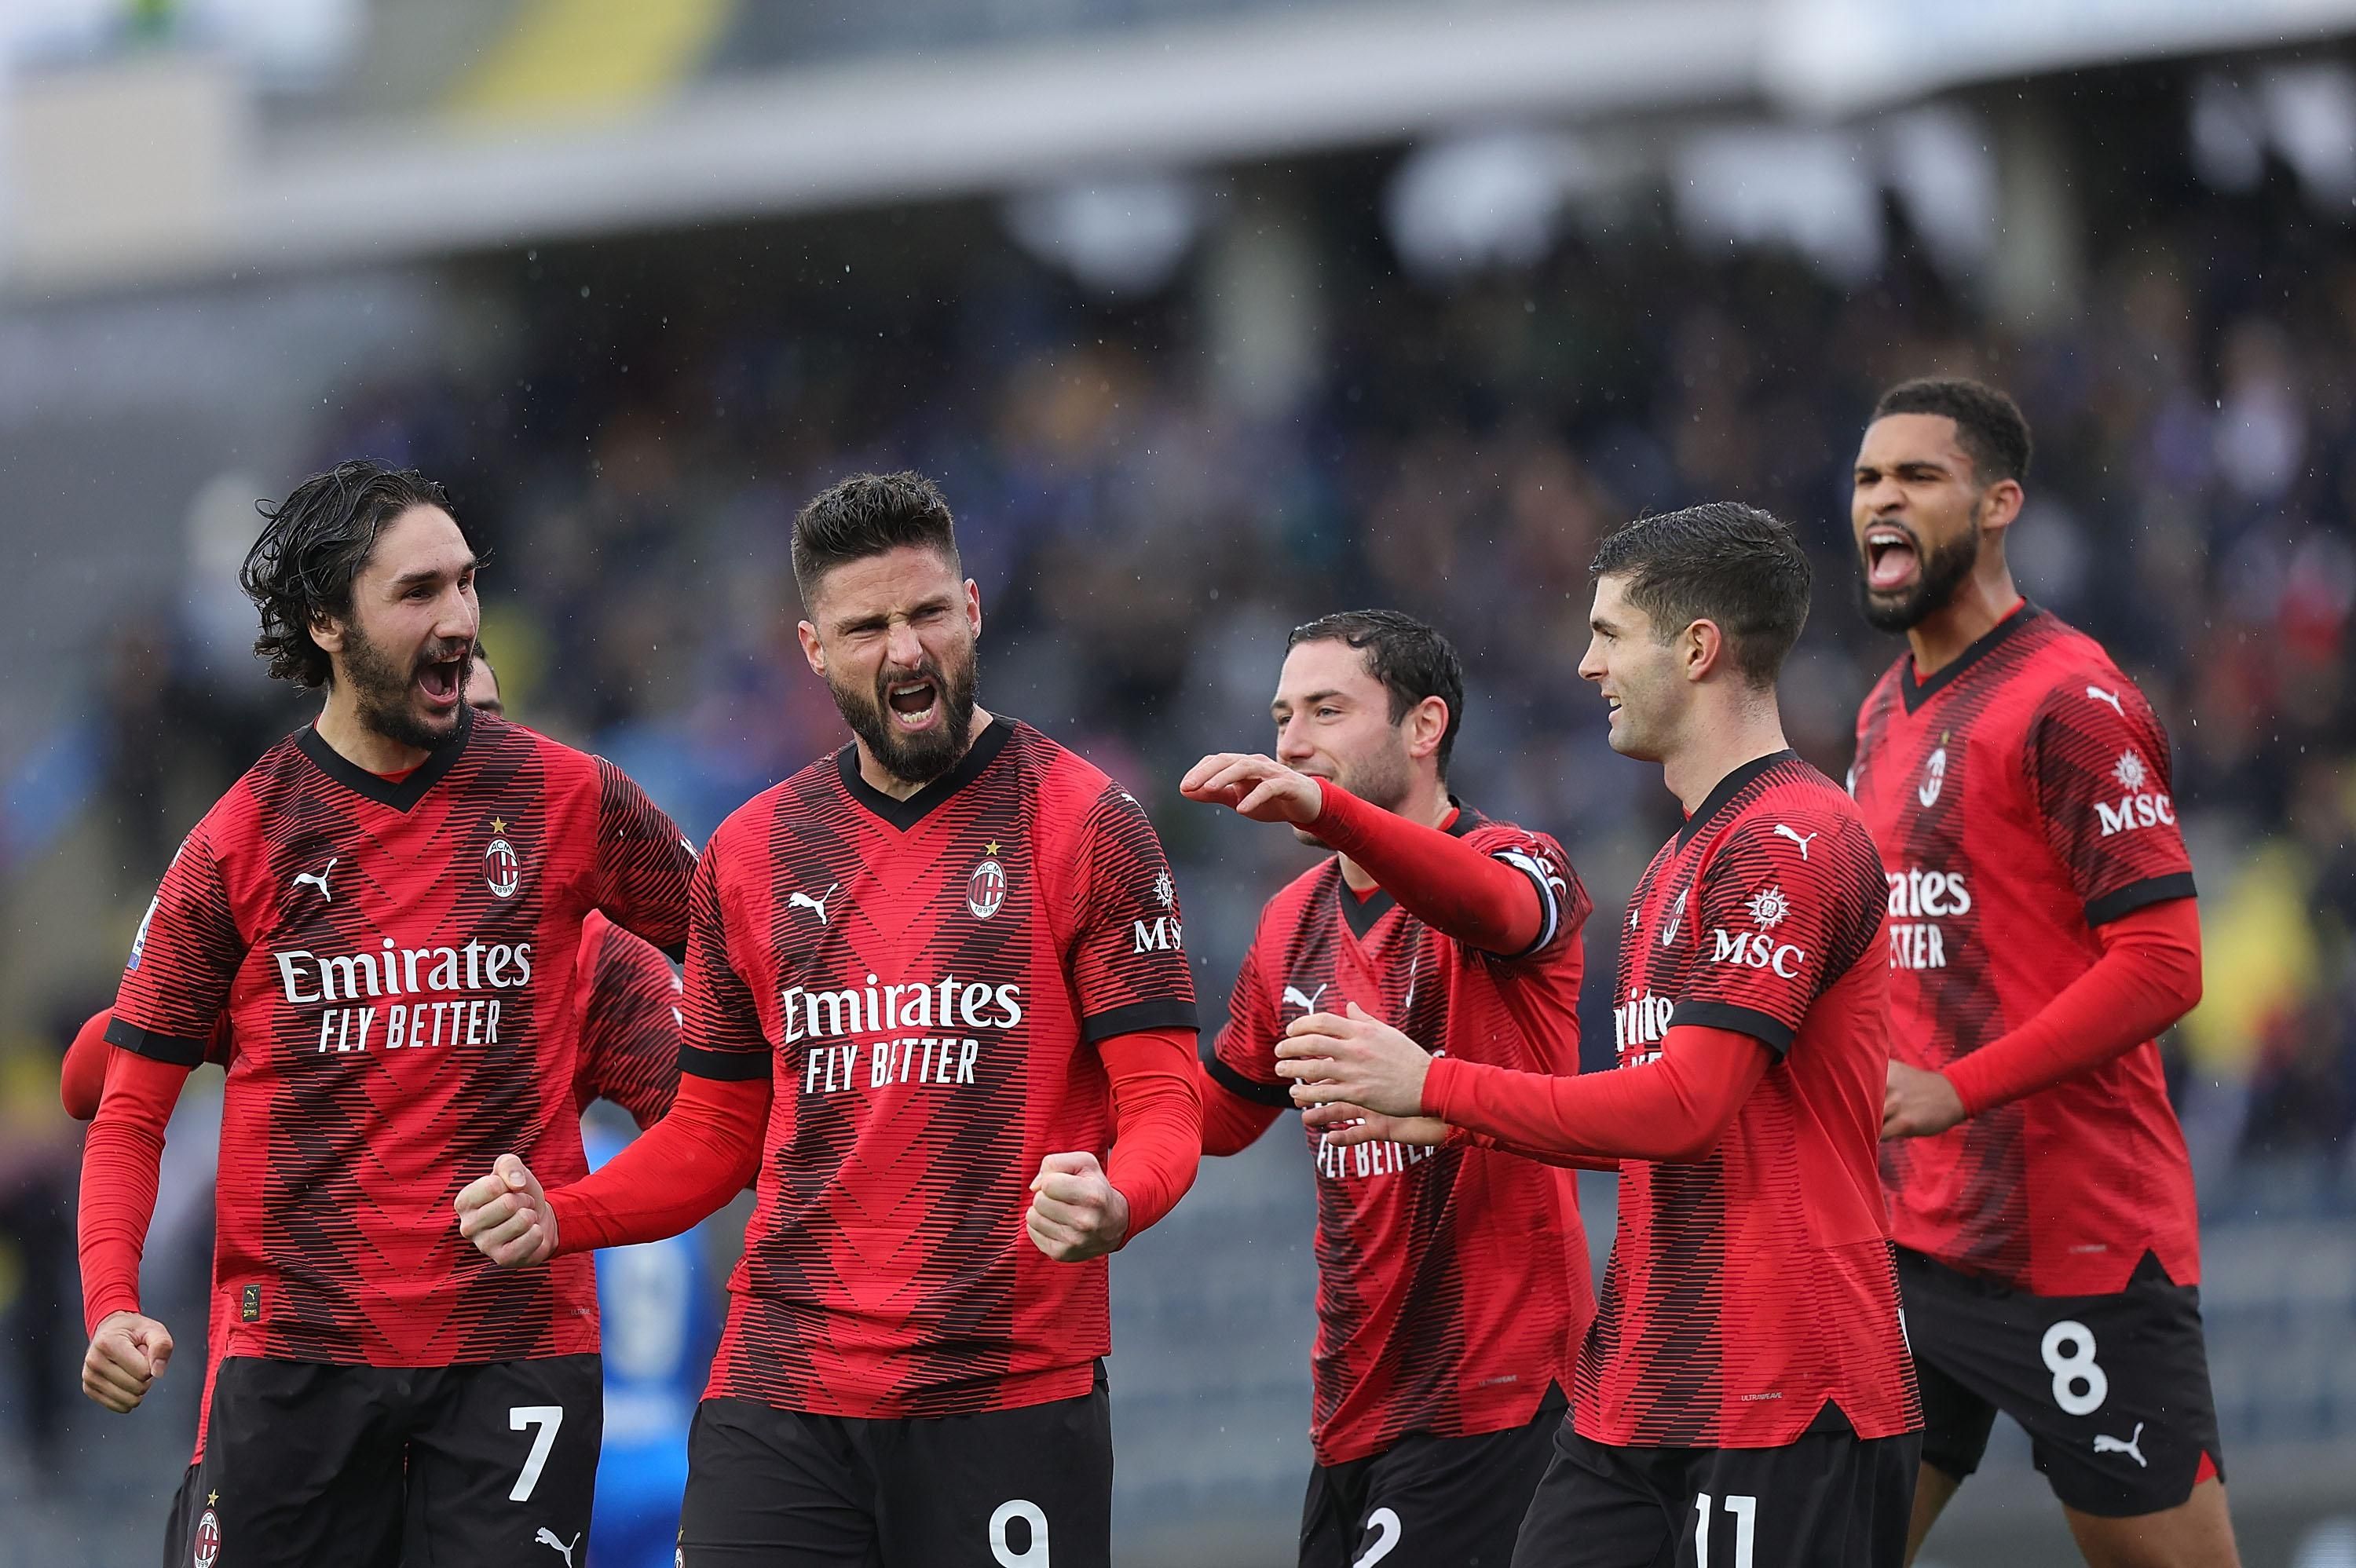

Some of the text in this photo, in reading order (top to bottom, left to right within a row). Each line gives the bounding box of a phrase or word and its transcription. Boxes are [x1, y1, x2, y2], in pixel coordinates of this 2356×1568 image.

[2094, 794, 2175, 837] MSC
[490, 841, 512, 853] ACM
[978, 863, 1001, 875] ACM
[1885, 867, 1971, 917] ates
[273, 937, 531, 1003] Emirates
[1710, 928, 1805, 978] MSC
[318, 1000, 500, 1053] FLY BETTER
[781, 974, 1022, 1044] Emirates
[806, 1038, 979, 1094] FLY BETTER
[2041, 1321, 2108, 1415] 8
[509, 1405, 563, 1501] 7
[989, 1499, 1050, 1568] 9
[1352, 1507, 1402, 1568] 2
[1695, 1492, 1757, 1568] 11
